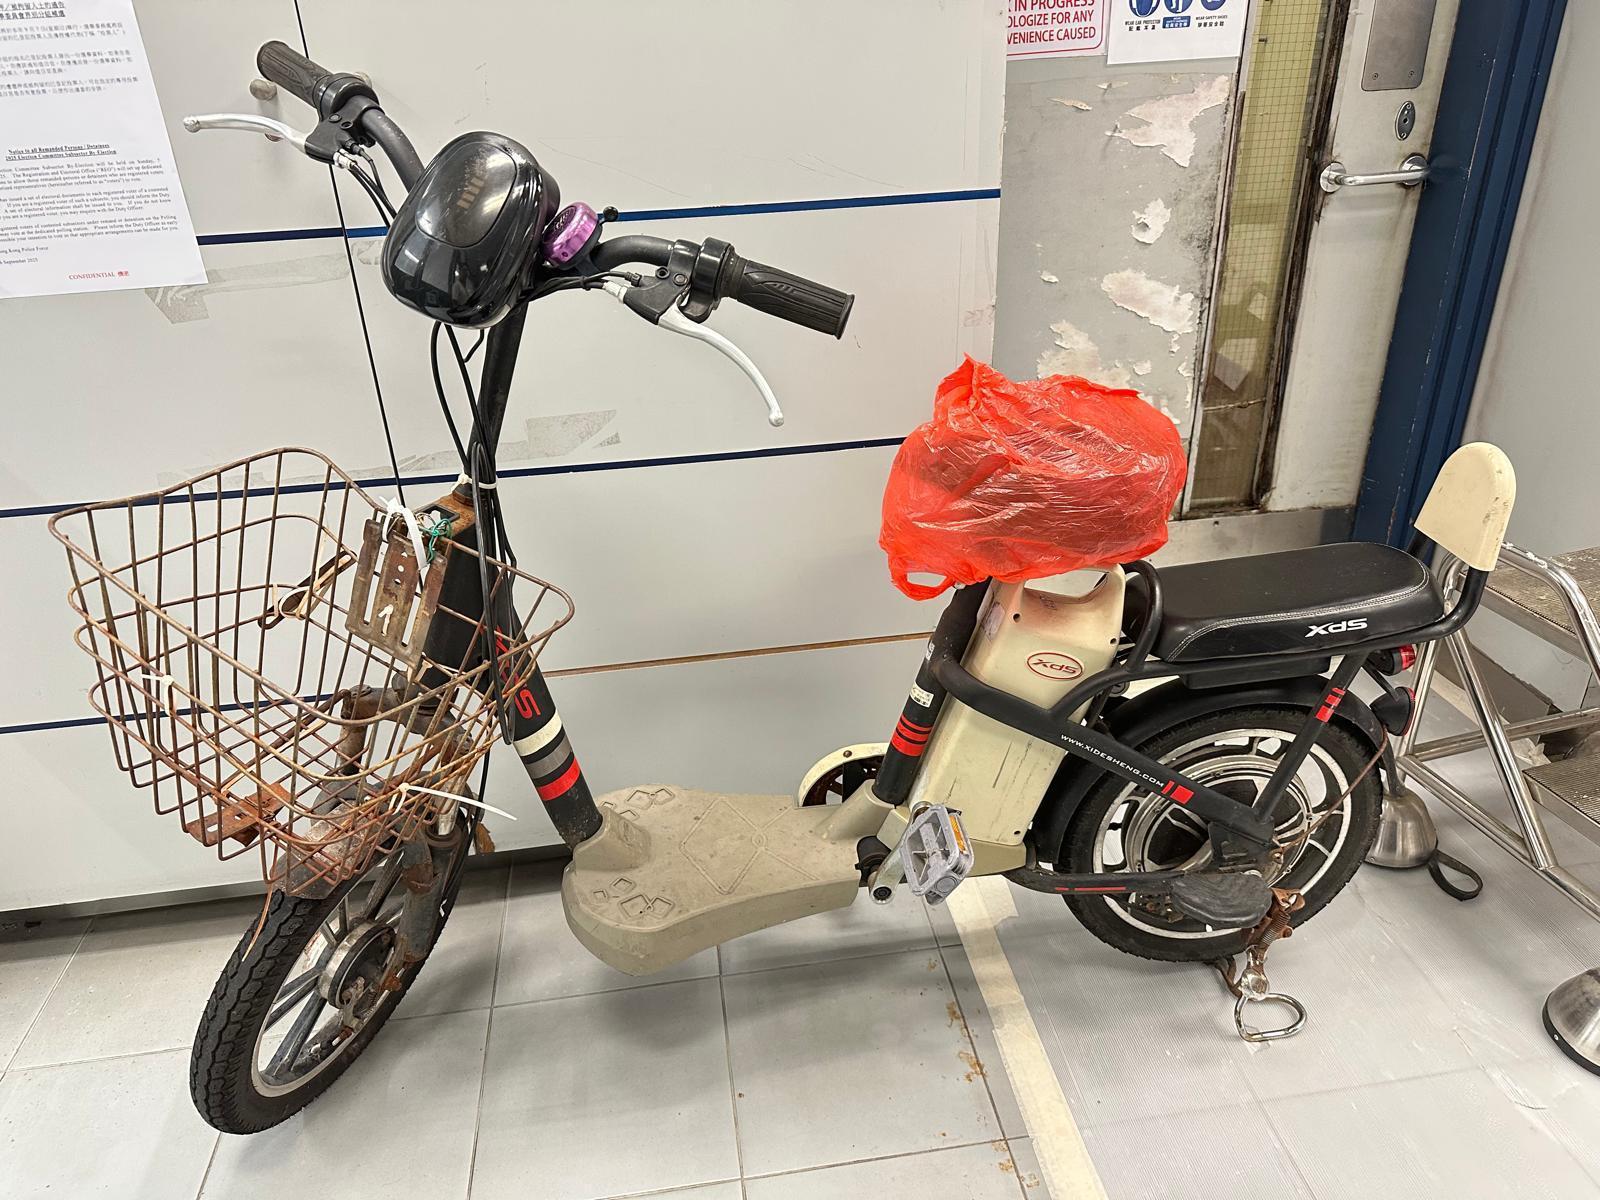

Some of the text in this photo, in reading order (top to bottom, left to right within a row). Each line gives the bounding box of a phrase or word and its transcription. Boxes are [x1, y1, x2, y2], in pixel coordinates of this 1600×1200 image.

[1050, 11, 1071, 24] FOR
[1072, 10, 1094, 22] ANY
[1056, 26, 1096, 40] CAUSED
[69, 272, 116, 280] CONFIDENTIAL
